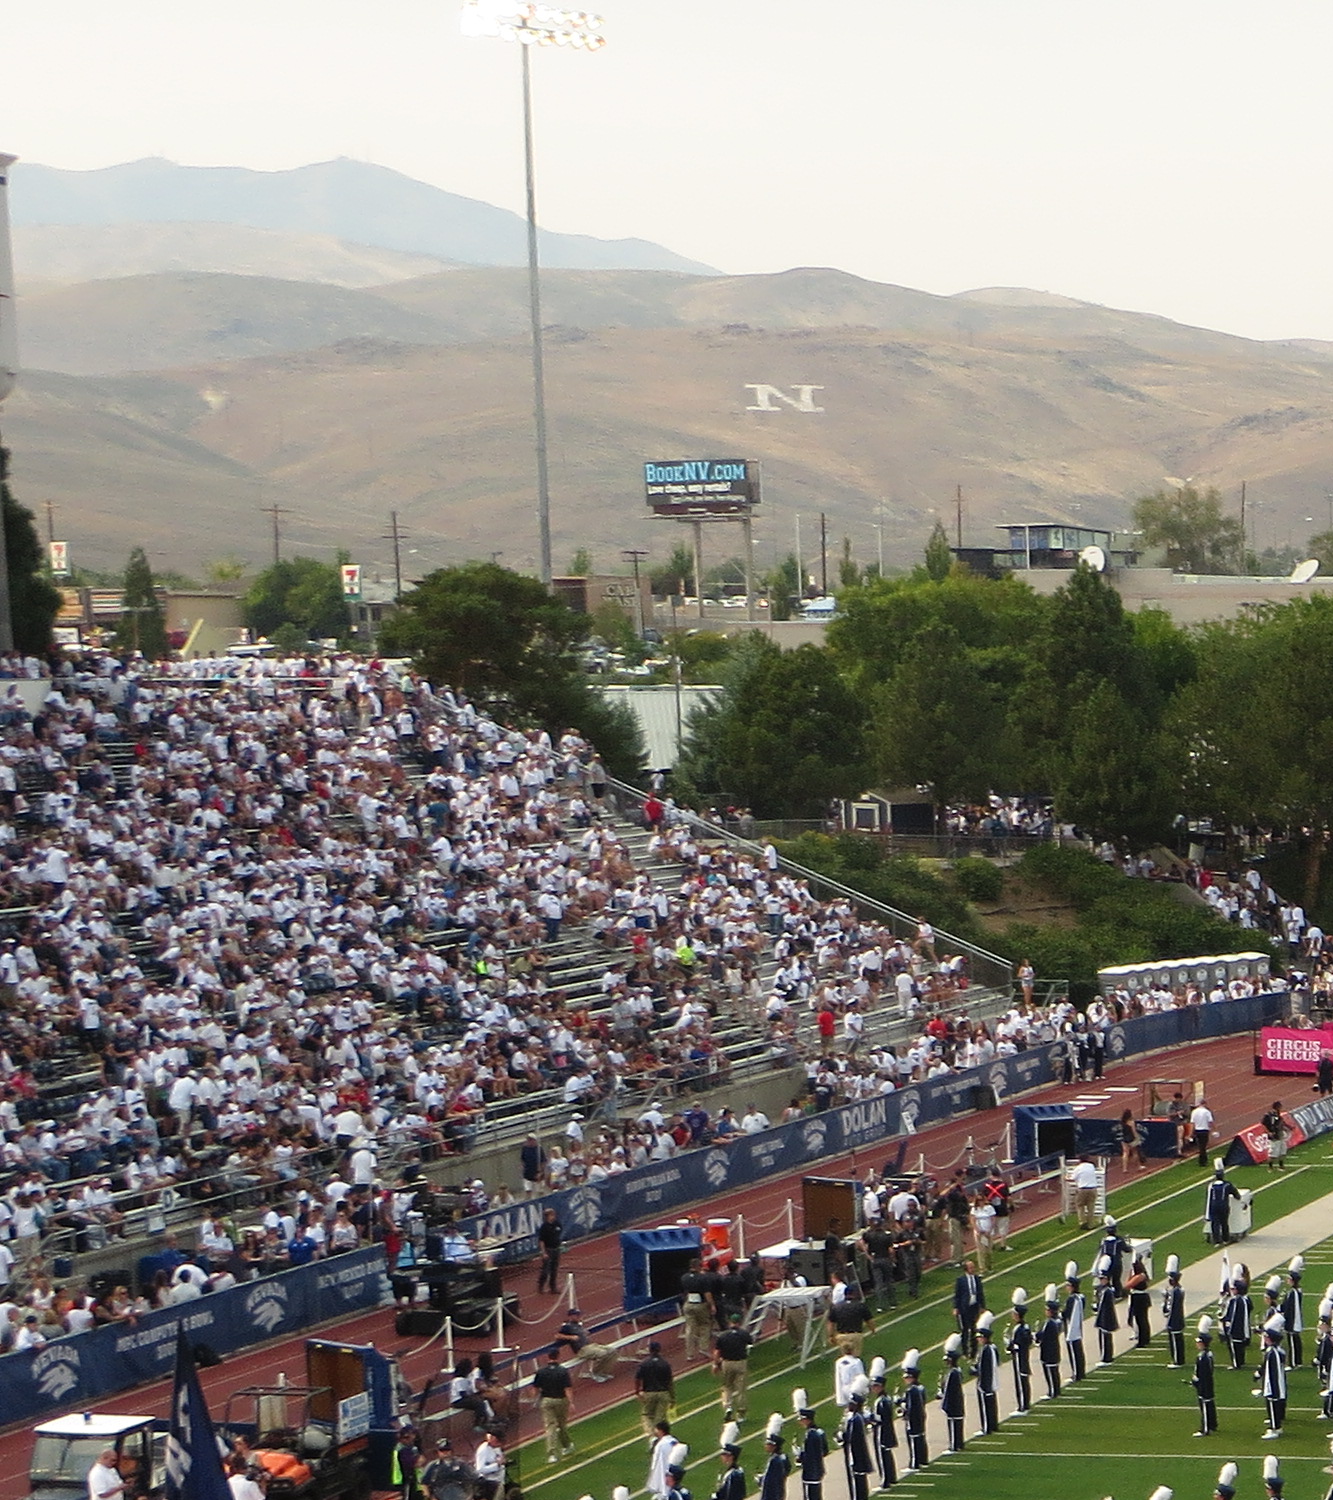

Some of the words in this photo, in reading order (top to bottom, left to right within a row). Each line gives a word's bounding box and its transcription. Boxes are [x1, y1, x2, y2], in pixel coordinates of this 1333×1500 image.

[745, 384, 824, 413] N
[1267, 1038, 1321, 1051] CIRCUS
[1267, 1050, 1321, 1062] CIRCUS
[842, 1099, 887, 1136] DOLAN
